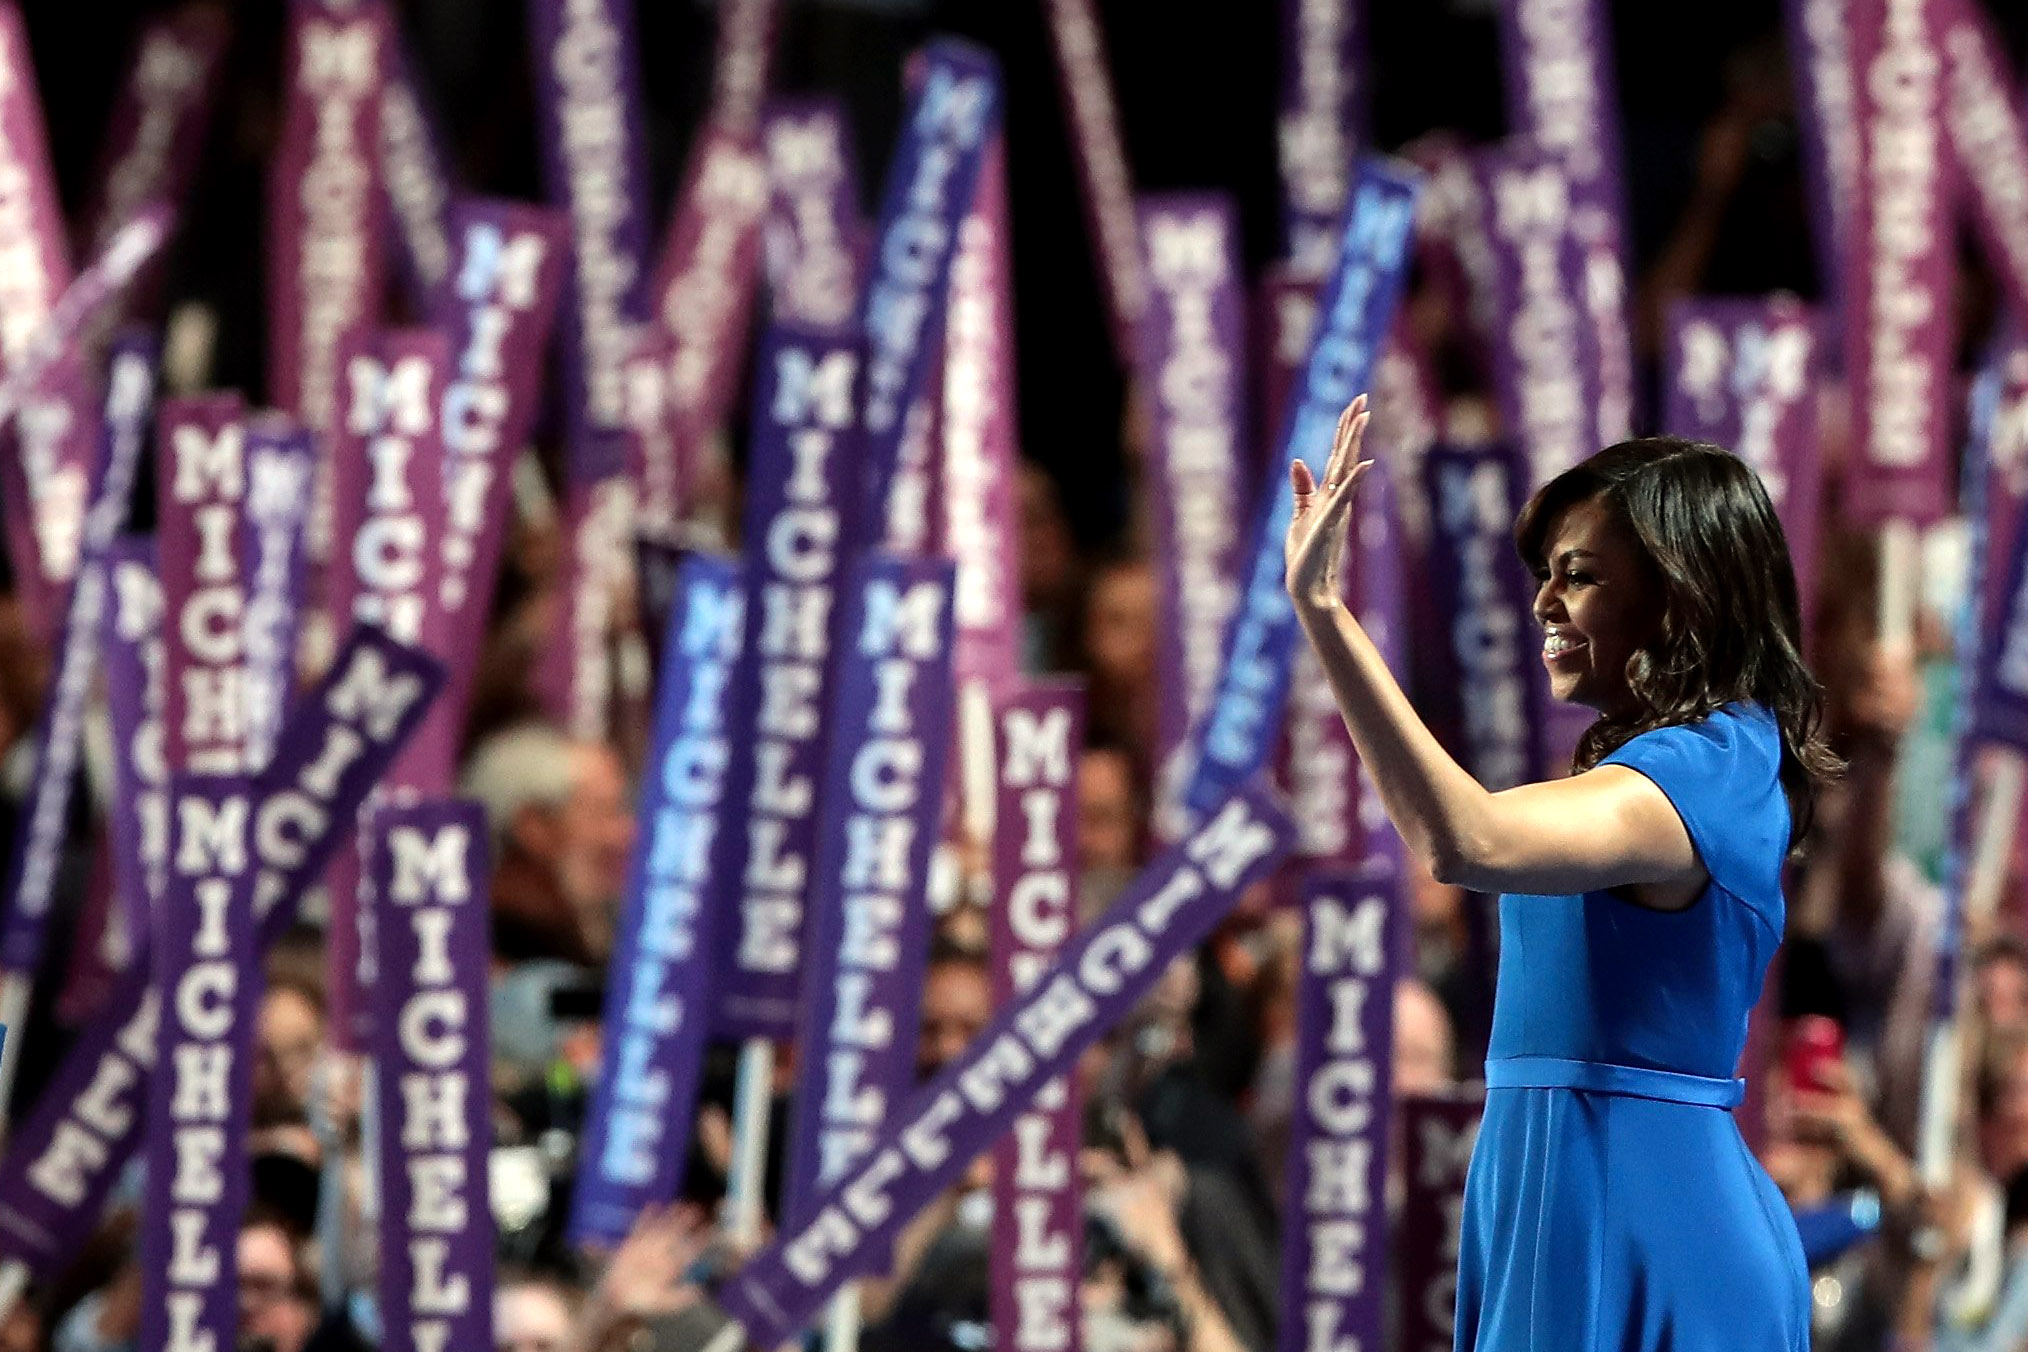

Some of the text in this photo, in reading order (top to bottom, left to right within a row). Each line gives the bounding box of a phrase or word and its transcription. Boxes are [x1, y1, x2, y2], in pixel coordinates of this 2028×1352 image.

[602, 578, 748, 1186] MICHELLE
[737, 346, 858, 974] MICHELLE
[783, 802, 1277, 1286] MICHELLE
[1002, 706, 1074, 1352] MICLLE
